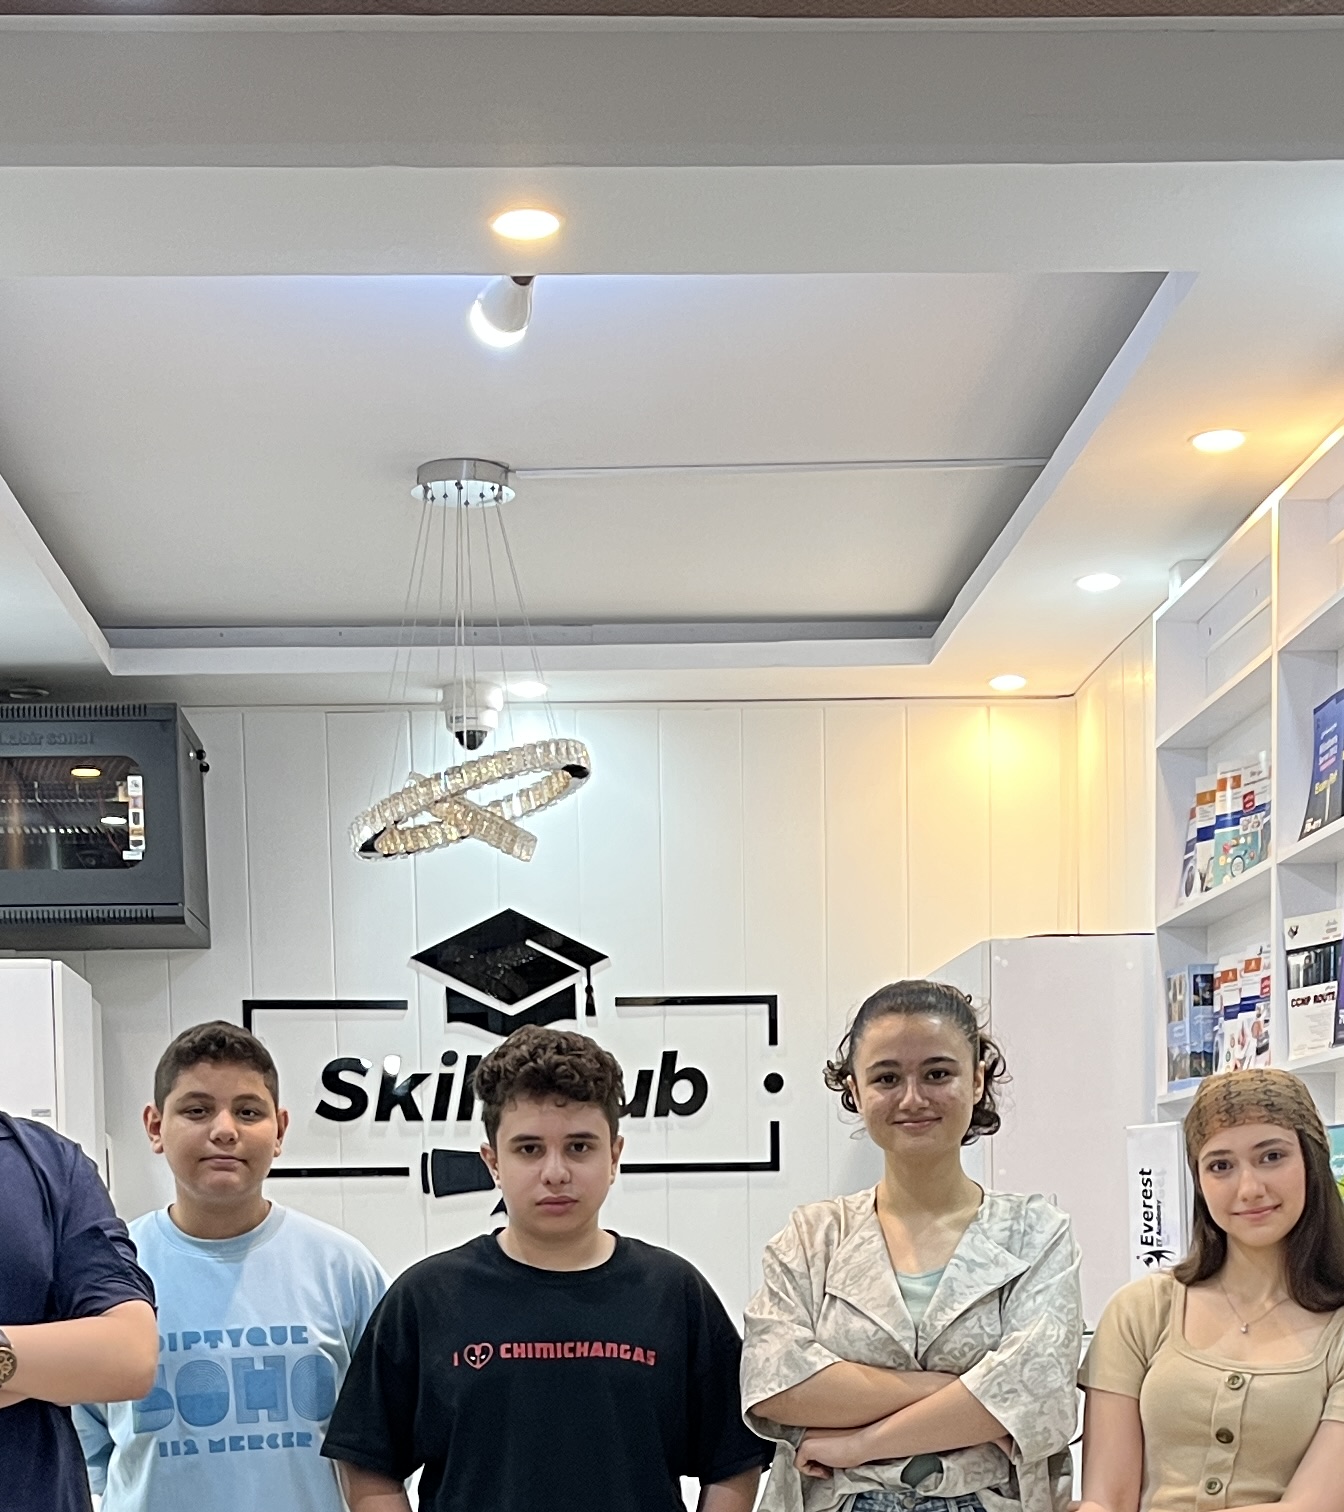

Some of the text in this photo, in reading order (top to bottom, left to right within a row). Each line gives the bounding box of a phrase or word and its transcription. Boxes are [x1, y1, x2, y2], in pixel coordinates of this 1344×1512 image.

[315, 1050, 484, 1122] Skil
[1138, 1168, 1154, 1247] Everest
[499, 1341, 657, 1367] CHIMICHANGAS
[158, 1431, 313, 1458] 112 MERCER
